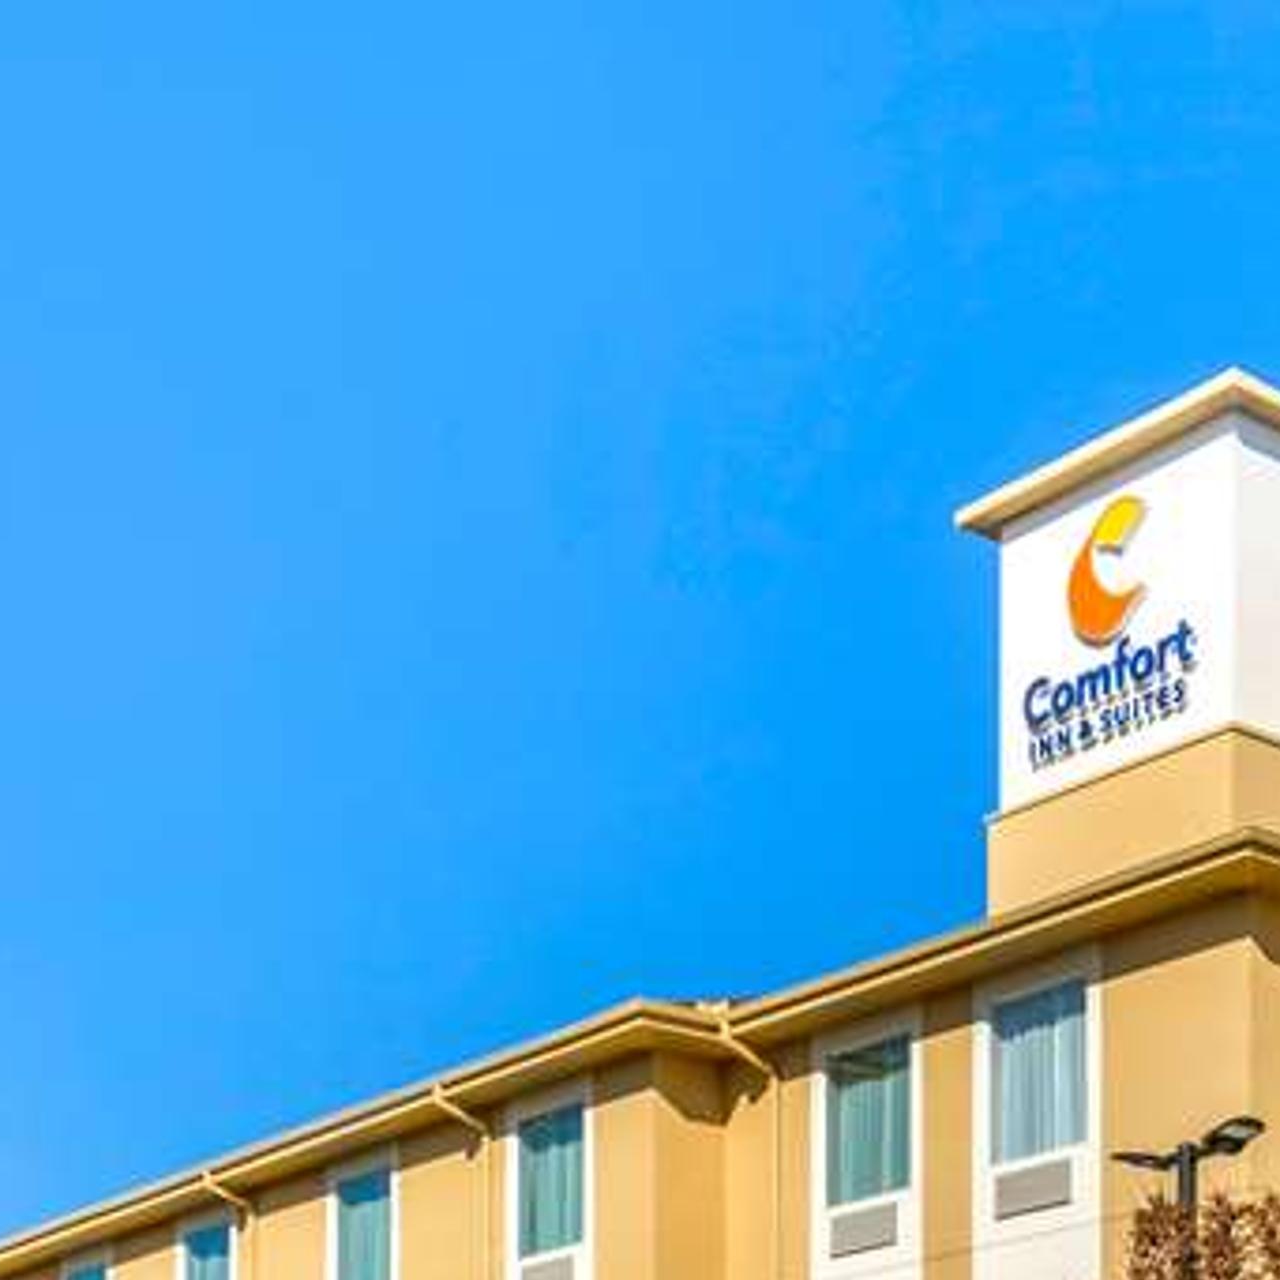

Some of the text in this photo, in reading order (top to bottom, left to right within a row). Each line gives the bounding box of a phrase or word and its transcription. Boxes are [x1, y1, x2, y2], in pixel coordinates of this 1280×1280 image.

[1023, 619, 1194, 730] Comfort
[1029, 727, 1074, 766] INN
[1098, 677, 1186, 733] SUITES
